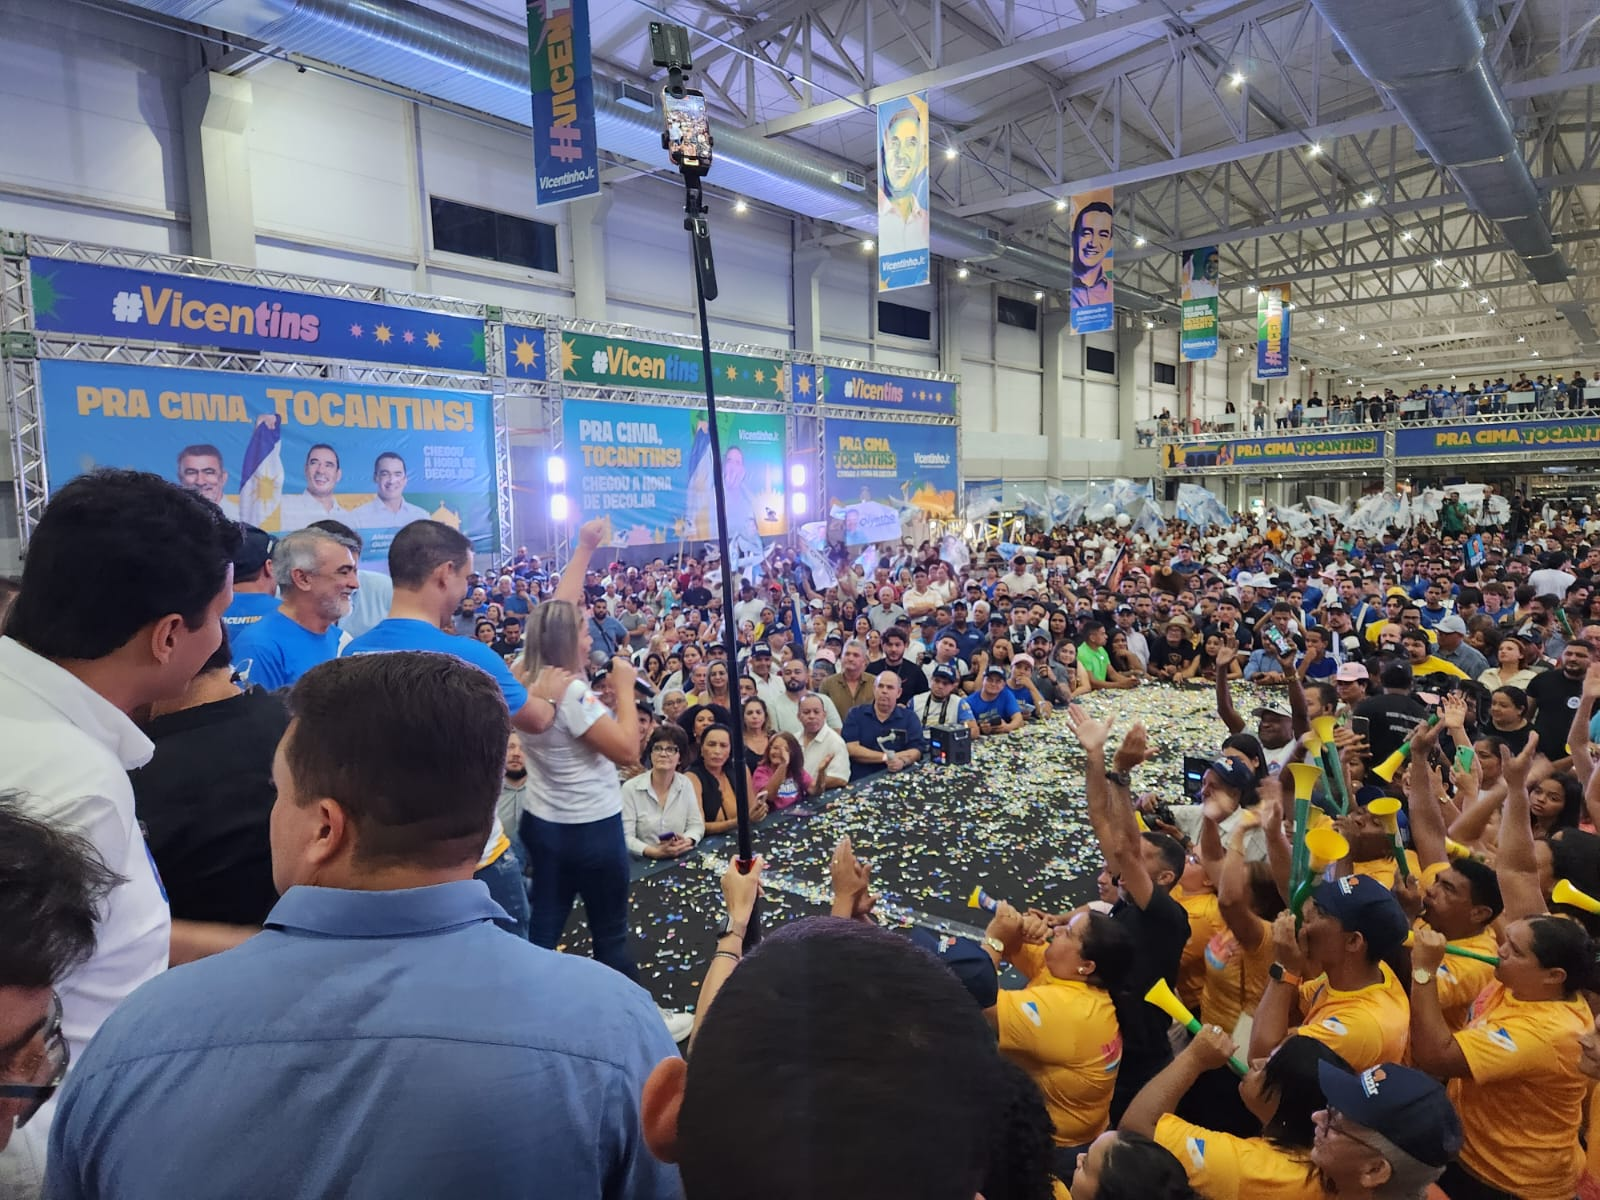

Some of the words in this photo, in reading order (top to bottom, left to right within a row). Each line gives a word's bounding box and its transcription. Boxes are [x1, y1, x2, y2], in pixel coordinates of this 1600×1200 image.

[112, 285, 320, 342] #Vicentins
[592, 345, 699, 384] #Vicentins
[844, 377, 904, 402] #Vicentins
[76, 385, 151, 418] PRA
[266, 388, 475, 432] TOCANTINS!
[579, 419, 614, 443] PRA
[616, 422, 663, 445] CIMA,
[839, 435, 863, 451] PRA
[1436, 430, 1472, 446] PRA
[581, 445, 682, 469] TOCANTINS!
[1237, 444, 1262, 457] PRA
[1295, 437, 1377, 457] TOCANTINS!
[582, 475, 630, 492] CHEGOU
[632, 476, 641, 491] A
[583, 493, 601, 510] DE
